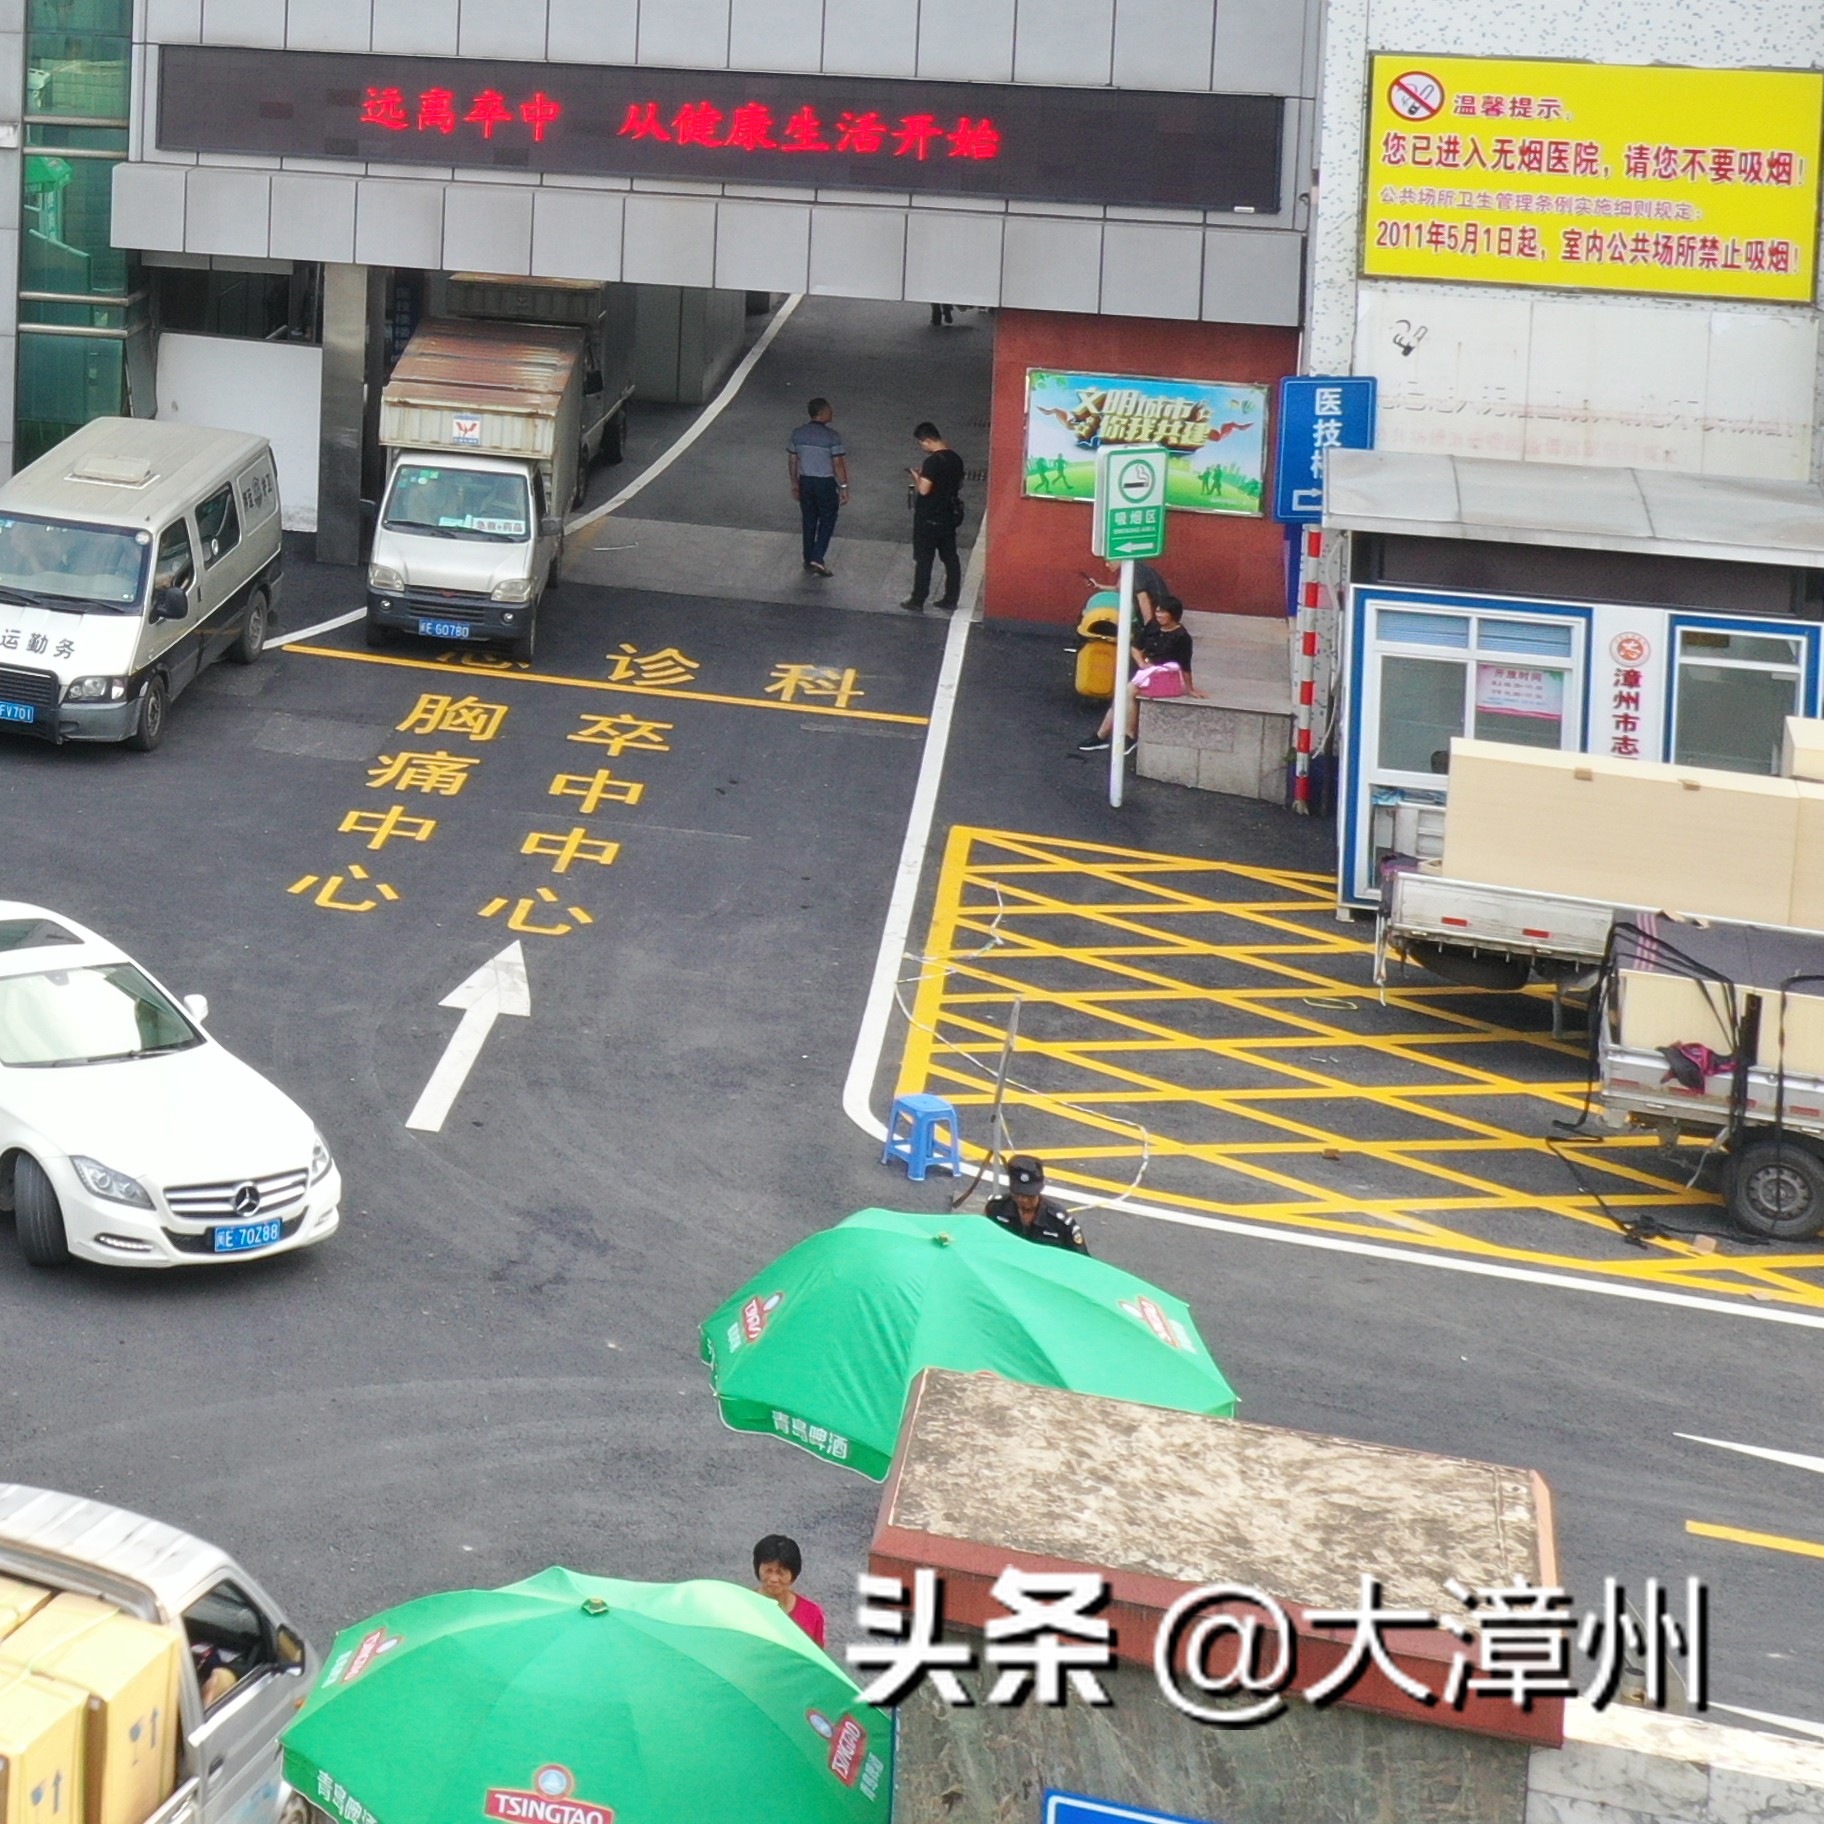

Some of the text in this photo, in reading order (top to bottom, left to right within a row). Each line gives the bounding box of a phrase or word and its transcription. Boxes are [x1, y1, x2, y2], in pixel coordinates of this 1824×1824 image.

[360, 86, 1001, 161] 远离卒中 从健康生活开始
[1076, 387, 1194, 420] 文明城市
[1100, 416, 1210, 446] 你我共建
[1610, 668, 1643, 760] 漳州市志
[288, 693, 509, 912] 胸痛中心
[478, 713, 673, 935] 卒中中心
